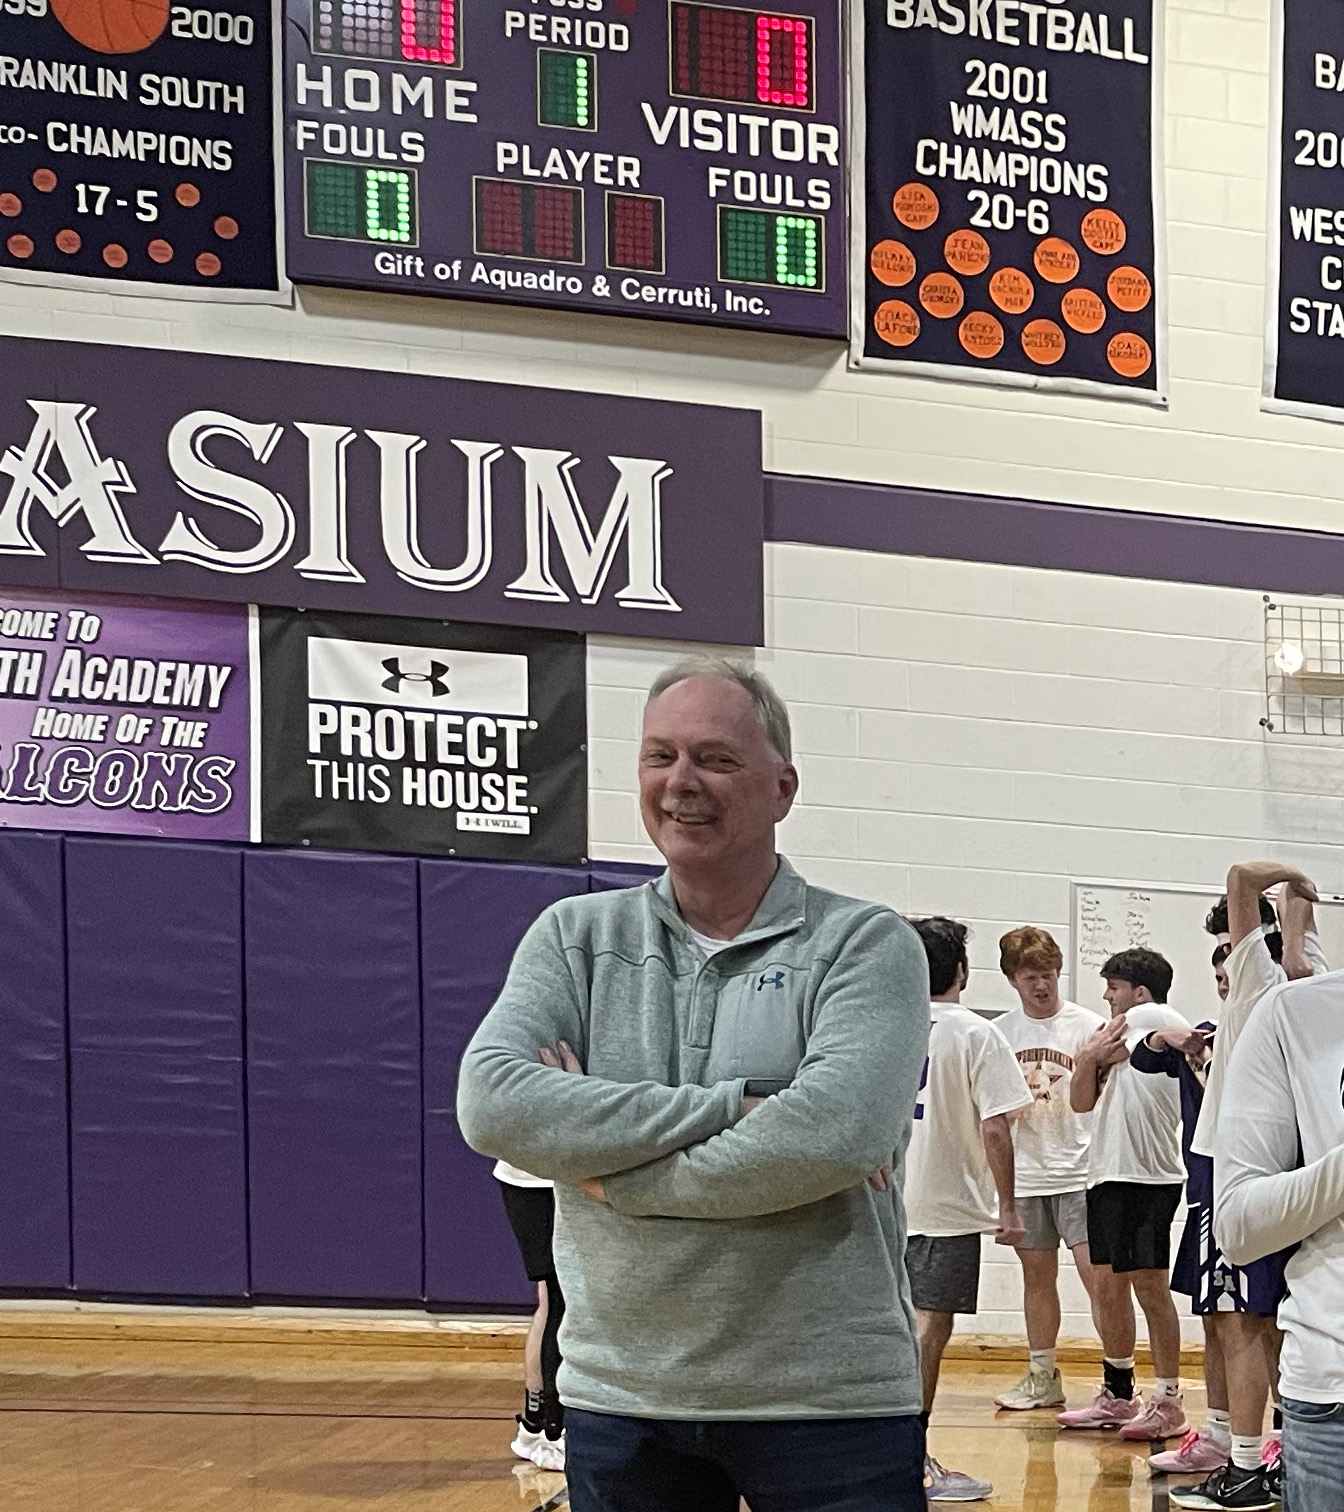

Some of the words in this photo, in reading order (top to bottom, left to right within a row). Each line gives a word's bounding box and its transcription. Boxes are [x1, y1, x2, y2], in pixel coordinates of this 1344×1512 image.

[171, 7, 253, 45] 2000
[505, 12, 629, 51] PERIOD
[886, 6, 1150, 65] BASKETBALL
[0, 56, 127, 100] RANKLIN
[139, 74, 244, 114] SOUTH
[296, 63, 480, 124] HOME
[965, 59, 1048, 104] 2001
[47, 122, 232, 171] CHAMPIONS
[297, 121, 425, 163] FOULS
[641, 103, 839, 166] VISITOR
[950, 102, 1066, 153] WMASS
[497, 142, 640, 188] PLAYER
[708, 168, 831, 208] FOULS
[915, 141, 1108, 202] CHAMPIONS
[969, 191, 1051, 236] 20-6
[375, 252, 426, 279] Gift
[433, 258, 461, 281] of
[470, 261, 582, 296] Aquadro
[591, 276, 611, 297] &
[620, 277, 717, 312] Cerruti,
[725, 289, 771, 316] Inc.
[0, 399, 681, 613] ASIUM
[52, 649, 232, 708] ACADEMY
[309, 704, 523, 770] PROTECT
[0, 744, 236, 813] LCONS
[307, 760, 391, 803] THIS
[402, 767, 538, 813] HOUSE.
